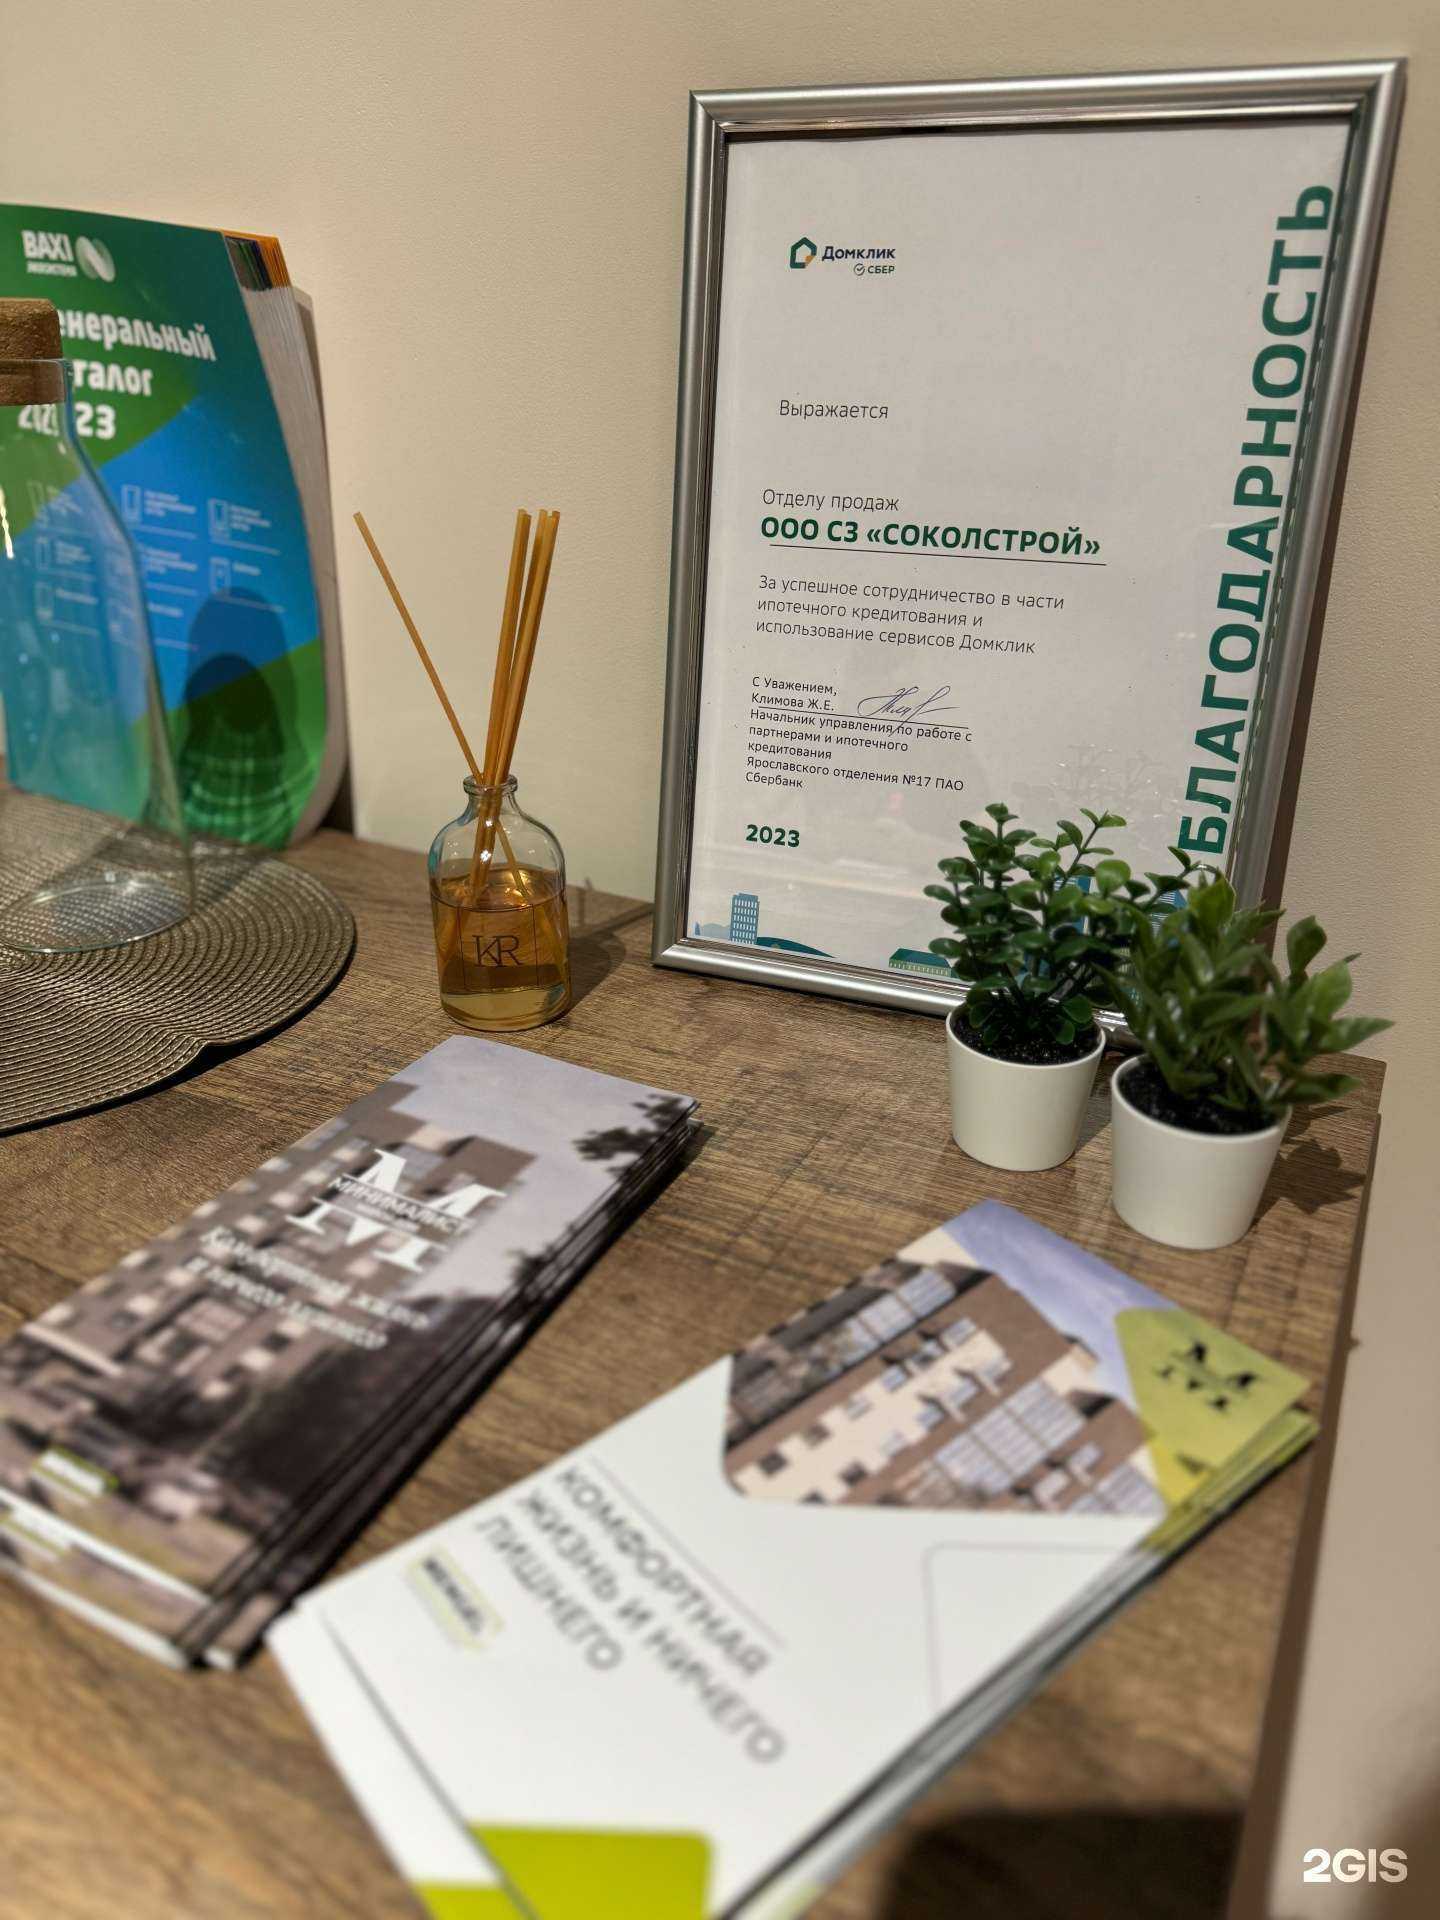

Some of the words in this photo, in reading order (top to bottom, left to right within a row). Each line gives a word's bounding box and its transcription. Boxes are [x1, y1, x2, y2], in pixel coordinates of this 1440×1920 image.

[21, 229, 75, 262] BAXI
[821, 245, 896, 262] Домклик
[867, 264, 896, 275] СБЕР
[72, 358, 153, 397] талог
[779, 399, 889, 420] Выражается
[762, 488, 825, 510] Отделу
[831, 493, 900, 513] продаж
[760, 516, 820, 541] ООО
[866, 523, 1101, 556] «СОКОЛСТРОЙ»
[1177, 185, 1334, 855] БЛАГОДАРНОСТЬ
[758, 574, 777, 590] За
[781, 578, 858, 597] успешное
[862, 583, 996, 606] сотрудничество
[1001, 594, 1011, 606] в
[1015, 594, 1065, 610] части
[756, 599, 847, 618] ипотечного
[851, 606, 968, 627] кредитования
[972, 615, 983, 627] и
[755, 620, 874, 642] использование
[878, 630, 956, 648] сервисов
[958, 633, 1036, 655] Домклик
[751, 692, 805, 709] Климова
[807, 699, 835, 712] Ж.Е.
[752, 676, 760, 687] С
[763, 677, 838, 696] Уважением,
[748, 725, 822, 743] партнерами
[823, 734, 833, 744] и
[835, 735, 909, 752] ипотечного
[750, 708, 816, 726] Начальник
[818, 715, 894, 734] управления
[897, 725, 913, 736] по
[916, 727, 962, 742] работе
[965, 733, 973, 743] с
[747, 742, 833, 760] кредитования
[745, 771, 804, 789] Сбербанк
[746, 756, 830, 776] Ярославского
[832, 767, 899, 784] отделения
[902, 773, 932, 788] №17
[935, 777, 964, 792] ПАО
[744, 823, 801, 849] 2023
[471, 934, 525, 968] KR
[556, 1465, 771, 1679] КОМФОРТНАЯ
[473, 1514, 625, 1672] ЛИШНЕГО
[517, 1489, 620, 1604] ЖИЗНЬ
[616, 1599, 655, 1631] И
[645, 1626, 787, 1765] НИЧЕГО
